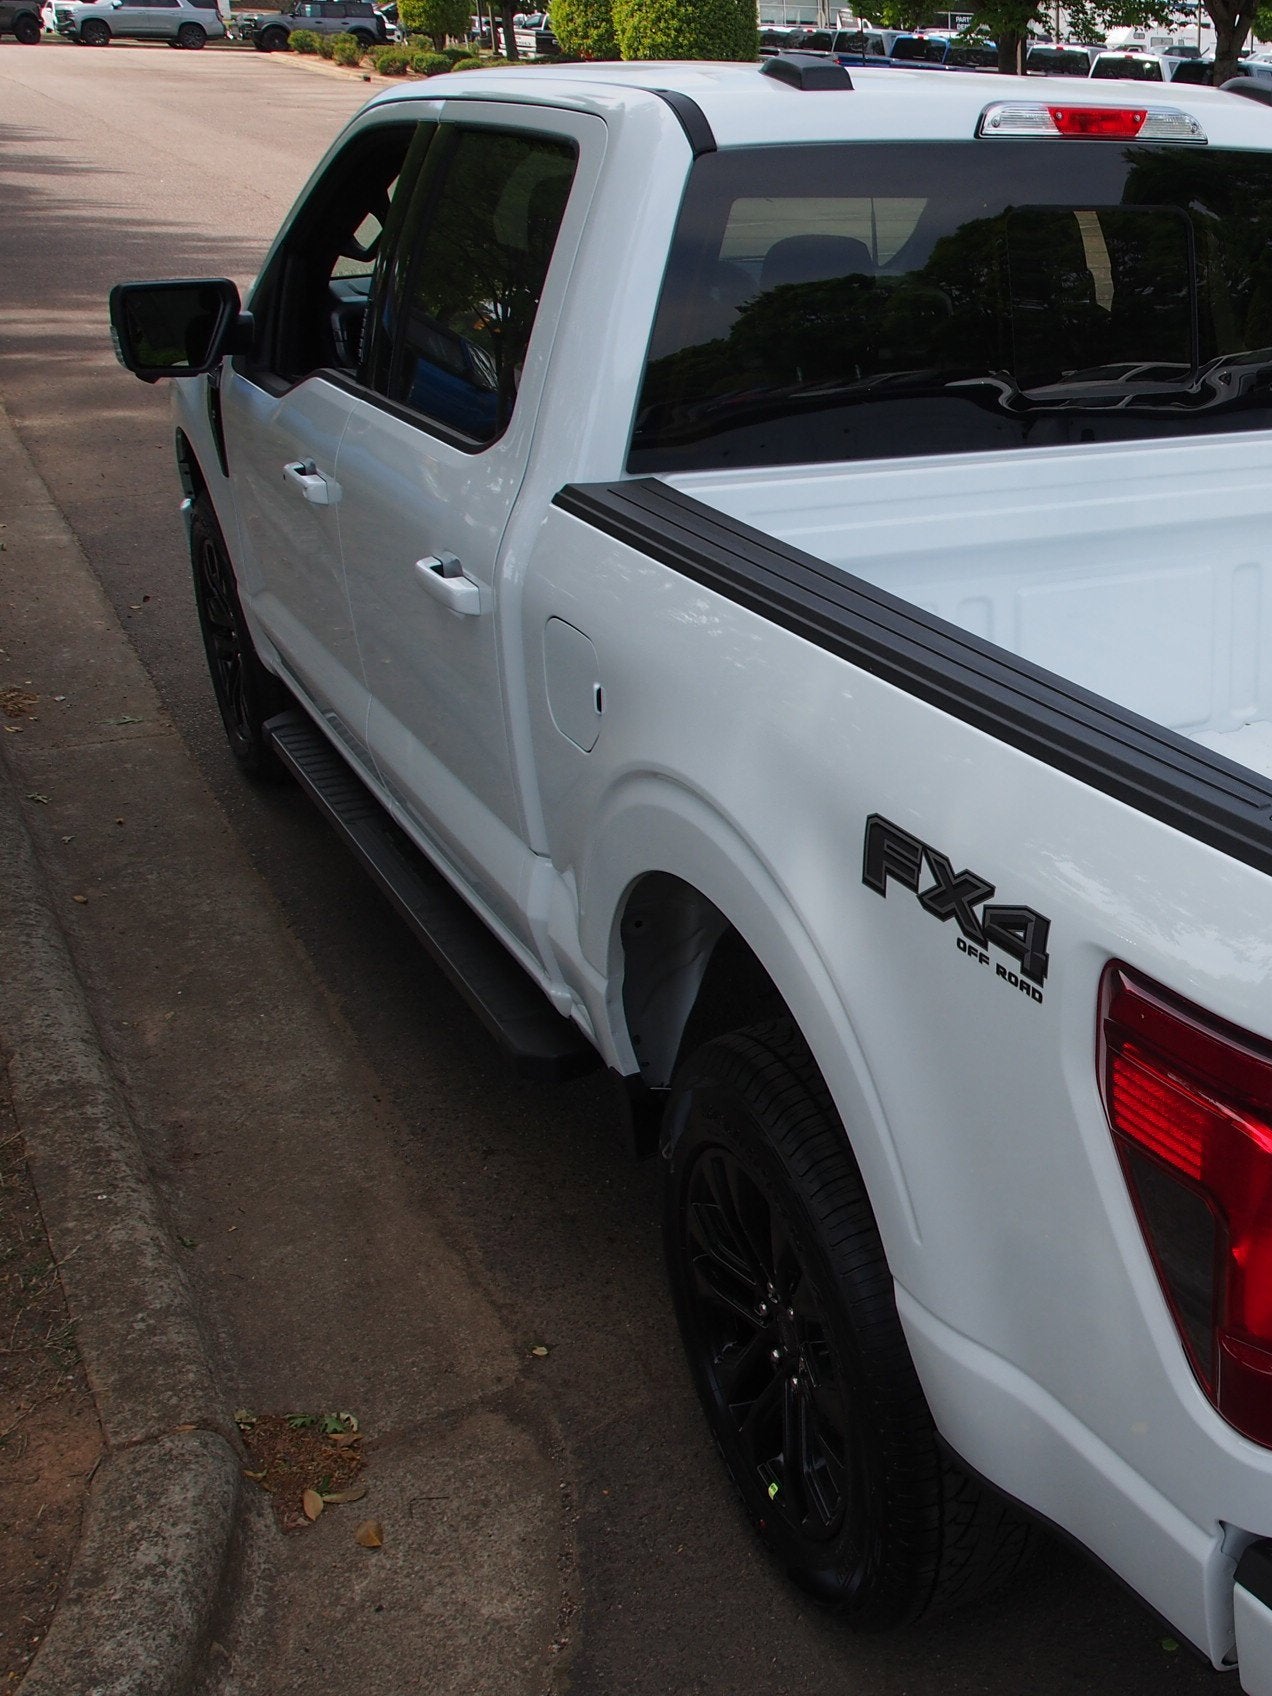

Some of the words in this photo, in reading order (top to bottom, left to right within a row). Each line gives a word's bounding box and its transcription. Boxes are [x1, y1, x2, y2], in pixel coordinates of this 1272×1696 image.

[861, 812, 1052, 989] FX4
[956, 936, 990, 966] OFF
[995, 962, 1044, 1004] ROAD
